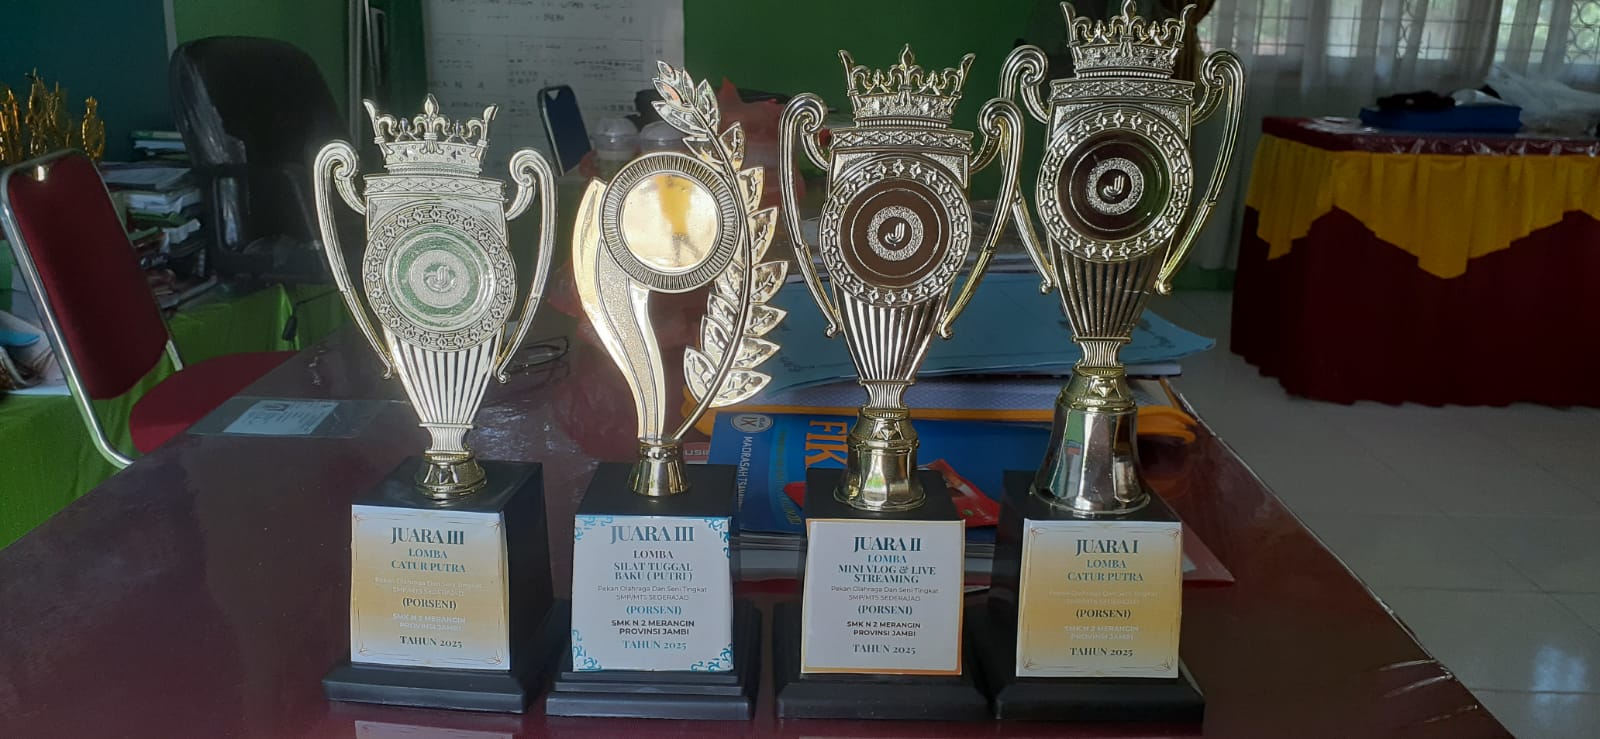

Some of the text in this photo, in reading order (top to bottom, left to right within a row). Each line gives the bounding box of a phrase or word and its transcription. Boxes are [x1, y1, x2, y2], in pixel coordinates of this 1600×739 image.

[740, 416, 758, 427] IX
[738, 436, 753, 476] MADRASAH
[390, 527, 464, 545] JUARA III
[610, 526, 694, 544] JUARA III
[854, 536, 921, 552] JUARA II
[1076, 539, 1138, 556] JUARA I
[408, 548, 448, 559] LOMBA
[634, 550, 674, 559] LOMBA
[868, 555, 907, 564] LOMBA
[1086, 560, 1126, 568] LOMBA
[392, 560, 466, 573] CATUR PUTRA
[614, 562, 693, 572] SILAT TUGGAL
[838, 565, 865, 574] MINI
[866, 566, 896, 574] VLOG
[911, 566, 936, 575] LIVE
[615, 572, 646, 580] BAKU
[854, 574, 918, 584] STREAMING
[1068, 572, 1144, 581] CATUR PUTRA
[402, 598, 456, 610] (PORSENI)
[626, 606, 682, 616] (PORSENI)
[858, 605, 912, 614] (PORSENI)
[1076, 609, 1131, 618] (PORSENI)
[400, 636, 462, 648] TAHUN 2025
[622, 640, 661, 649] TAHUN
[852, 644, 916, 655] TAHUN 2025
[1070, 648, 1107, 656] TAHUN
